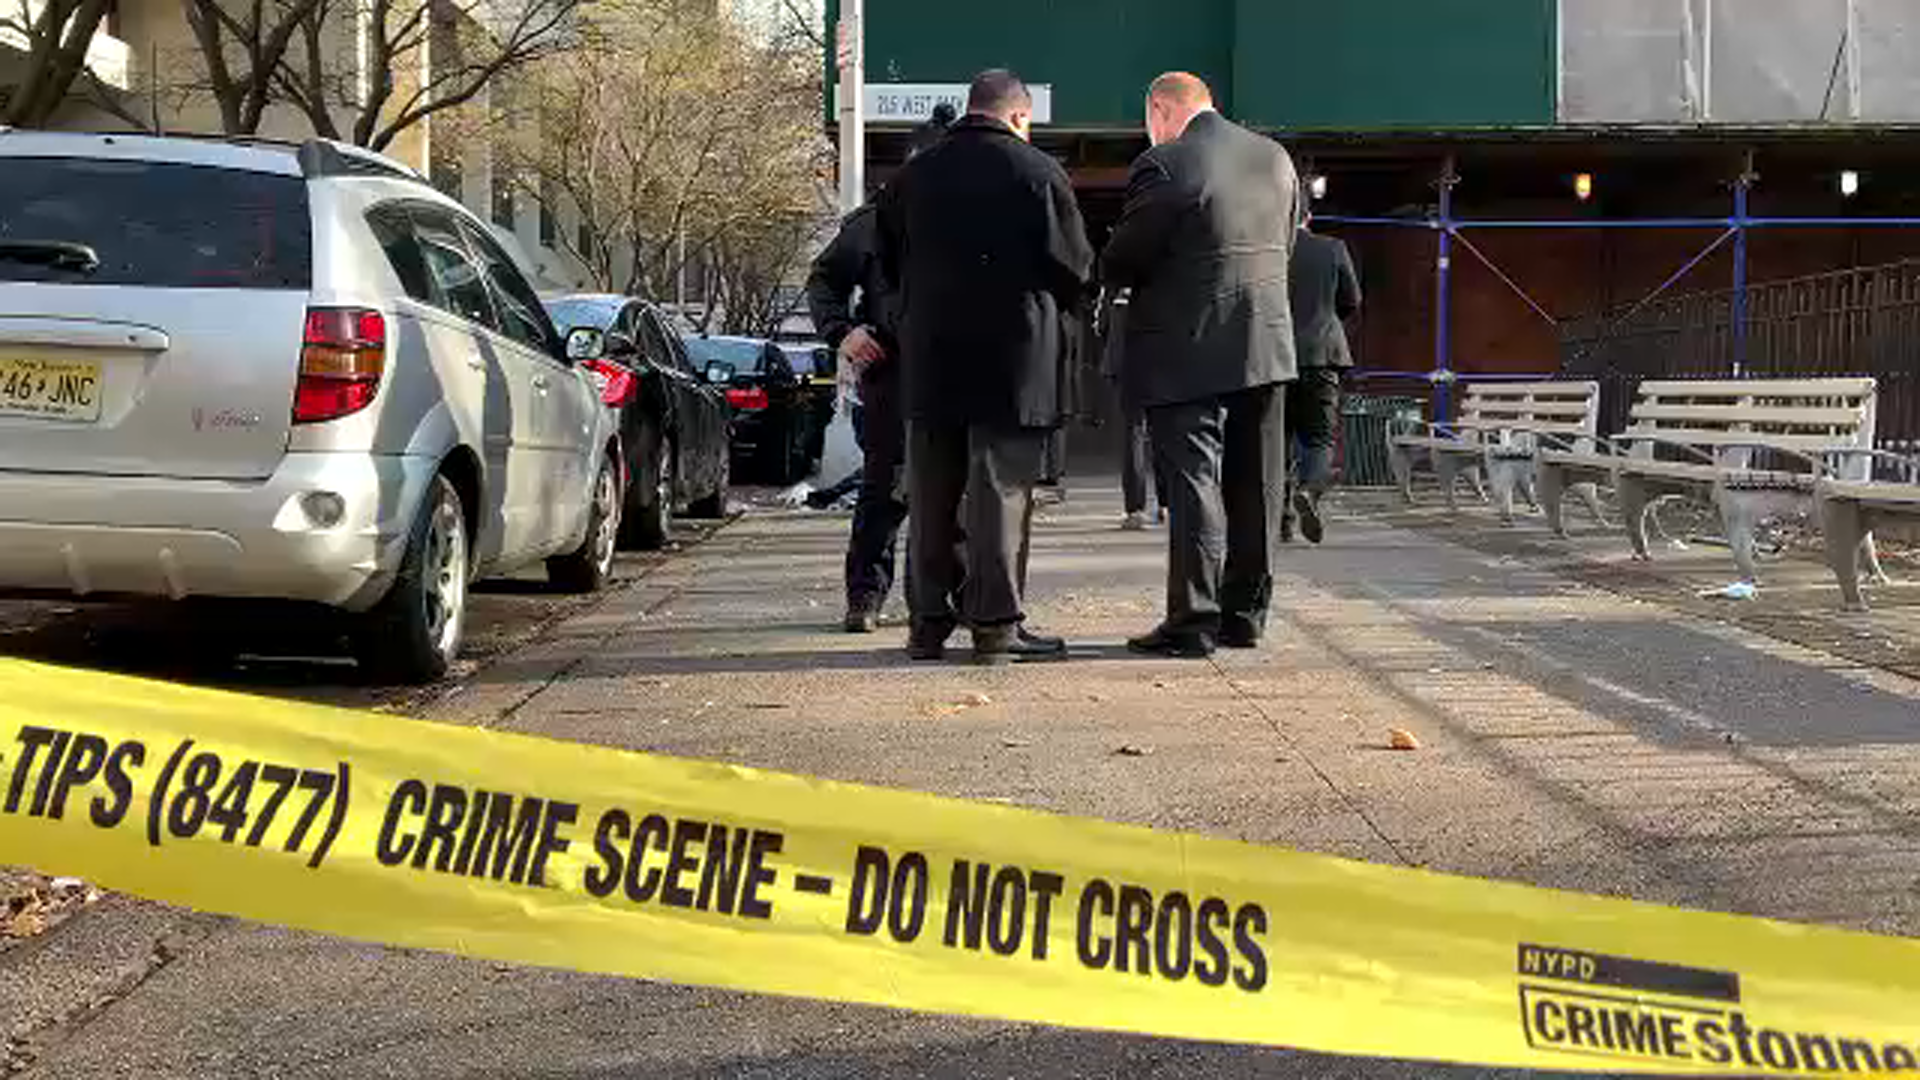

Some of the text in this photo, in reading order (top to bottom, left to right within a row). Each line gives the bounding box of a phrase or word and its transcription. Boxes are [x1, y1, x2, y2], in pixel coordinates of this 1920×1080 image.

[901, 94, 932, 114] WEST
[0, 369, 95, 406] 46 JNC
[0, 725, 146, 829] TIPS
[147, 740, 350, 869] (8477)
[376, 779, 580, 888] CRIME
[584, 808, 784, 920] SCENE
[845, 844, 929, 943] DO
[943, 858, 1065, 960] NOT
[1076, 878, 1268, 992] CROSS
[1522, 948, 1597, 982] NYPD
